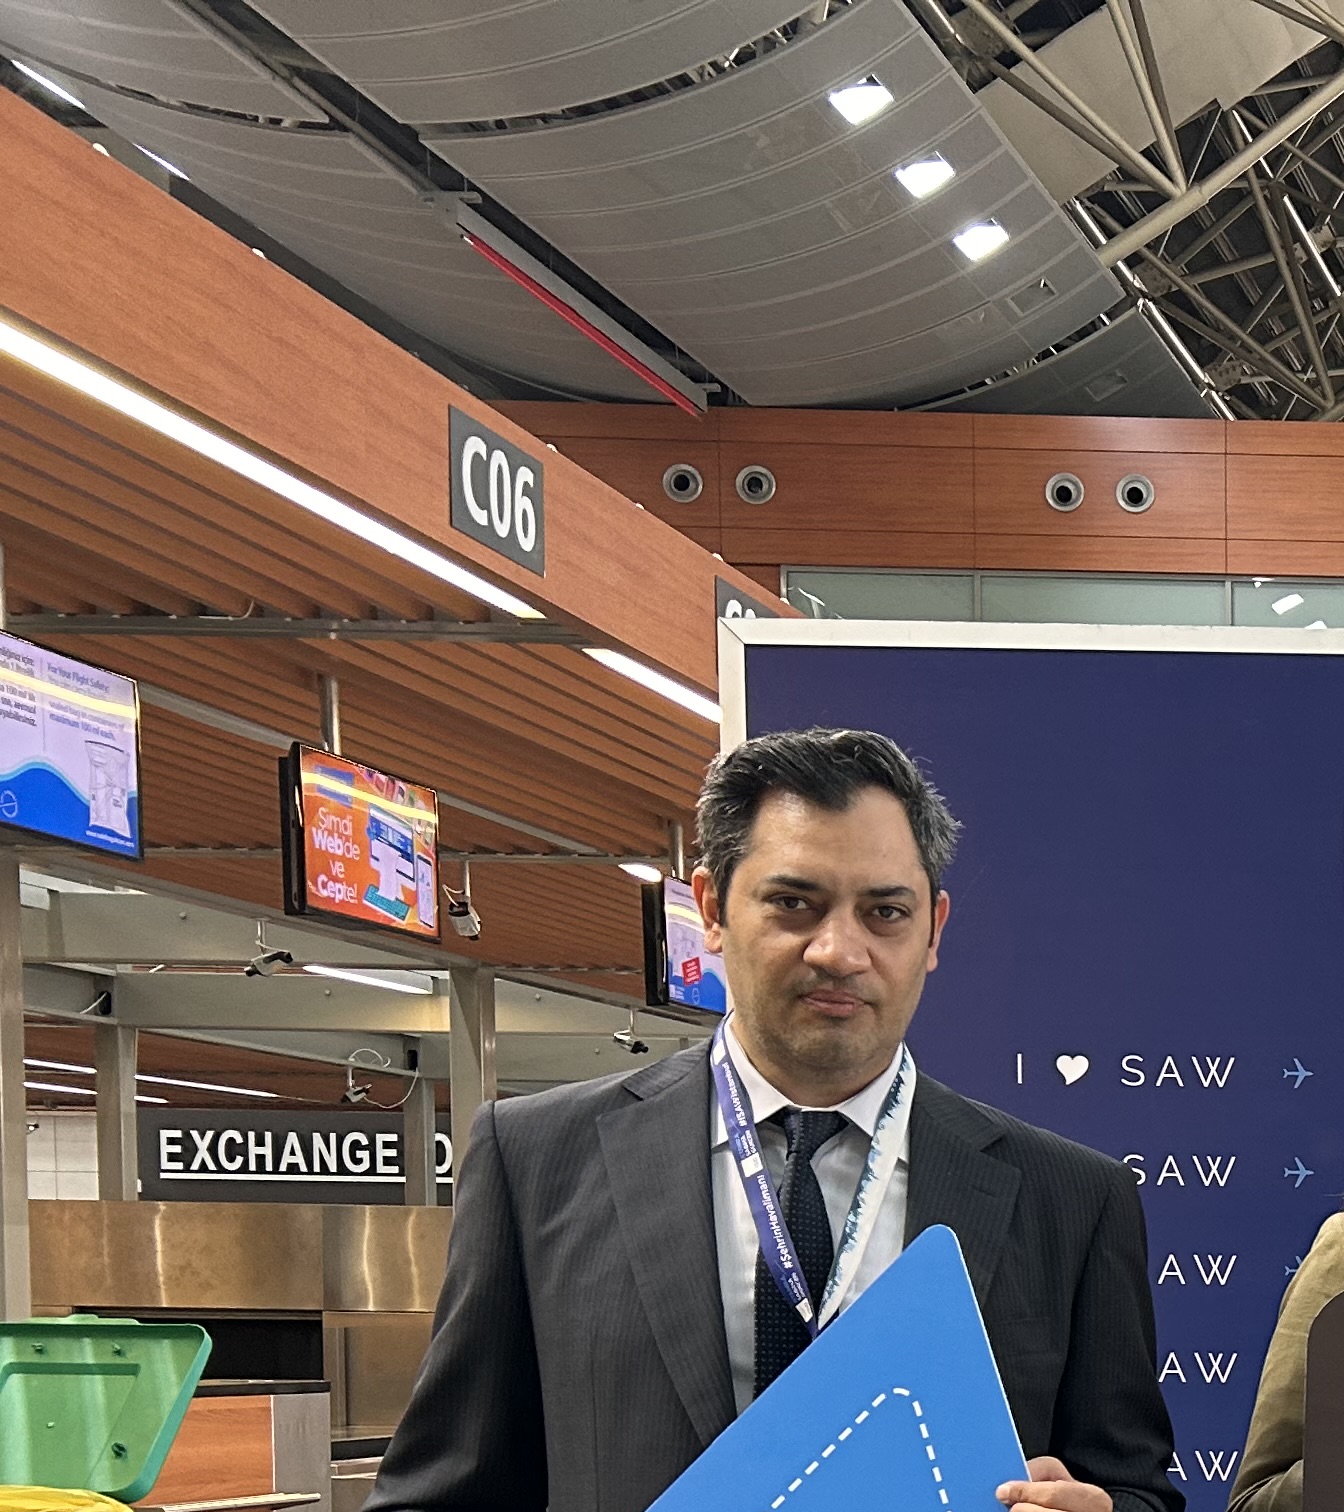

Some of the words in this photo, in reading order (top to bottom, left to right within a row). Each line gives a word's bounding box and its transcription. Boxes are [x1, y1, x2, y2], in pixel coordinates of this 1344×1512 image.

[461, 435, 537, 554] C06
[318, 806, 352, 836] Şimdi
[329, 859, 345, 879] ve
[1121, 1055, 1234, 1087] SAW
[159, 1129, 400, 1174] EXCHANGE
[1158, 1254, 1236, 1285] AW
[1159, 1352, 1237, 1383] AW
[1168, 1450, 1239, 1482] AW
